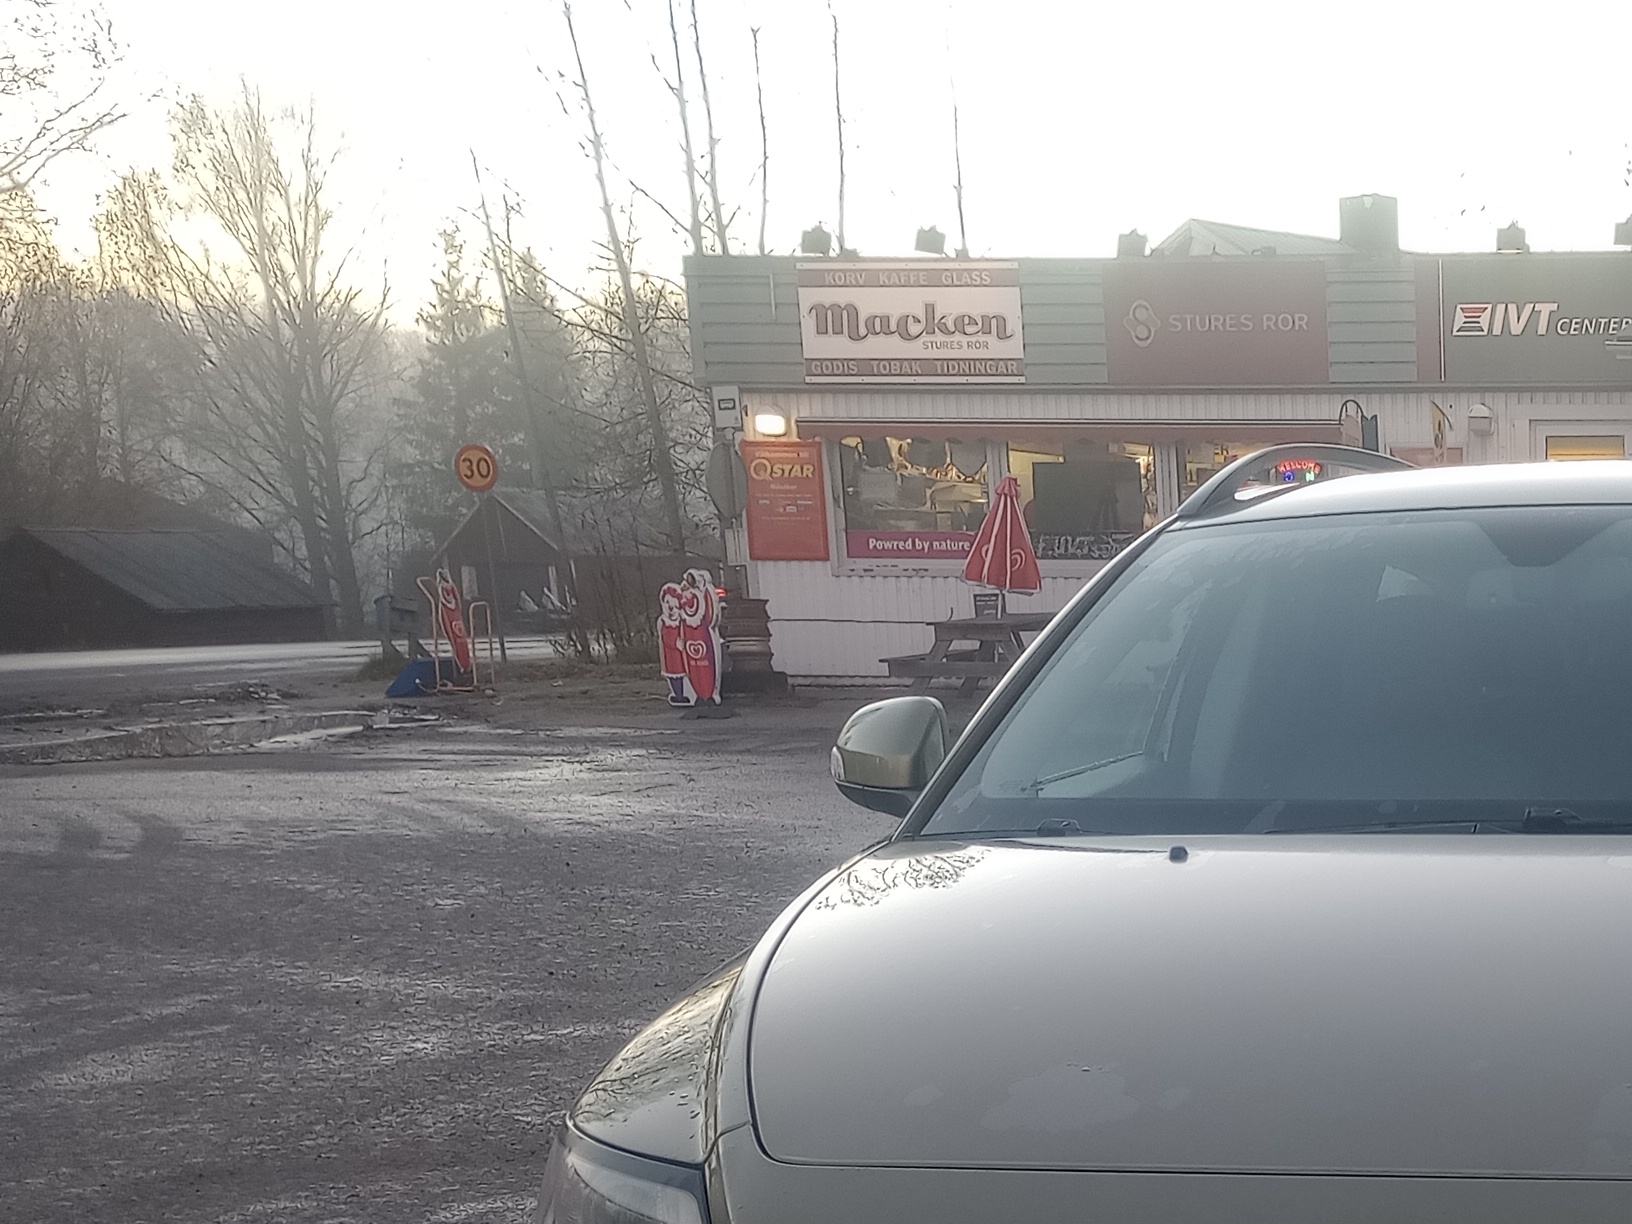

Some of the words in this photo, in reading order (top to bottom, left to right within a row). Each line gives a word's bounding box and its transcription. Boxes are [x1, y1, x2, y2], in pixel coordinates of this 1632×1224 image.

[824, 271, 866, 285] KORV
[879, 271, 928, 285] KAFFE
[942, 271, 991, 285] GLASS
[808, 302, 1014, 342] Macken
[1168, 313, 1254, 332] STURES
[1263, 309, 1308, 332] RÖR
[1491, 302, 1559, 336] IVT
[922, 341, 963, 350] STURES
[967, 339, 989, 350] RÖR
[811, 361, 858, 374] GODIS
[871, 361, 922, 374] TOBAK
[935, 361, 1018, 374] TIDNINGAR
[462, 457, 491, 479] 30
[750, 458, 815, 480] QSTAR
[1277, 460, 1322, 475] WELCOME
[868, 537, 912, 550] Powred
[915, 537, 930, 553] by
[933, 539, 971, 551] nature
